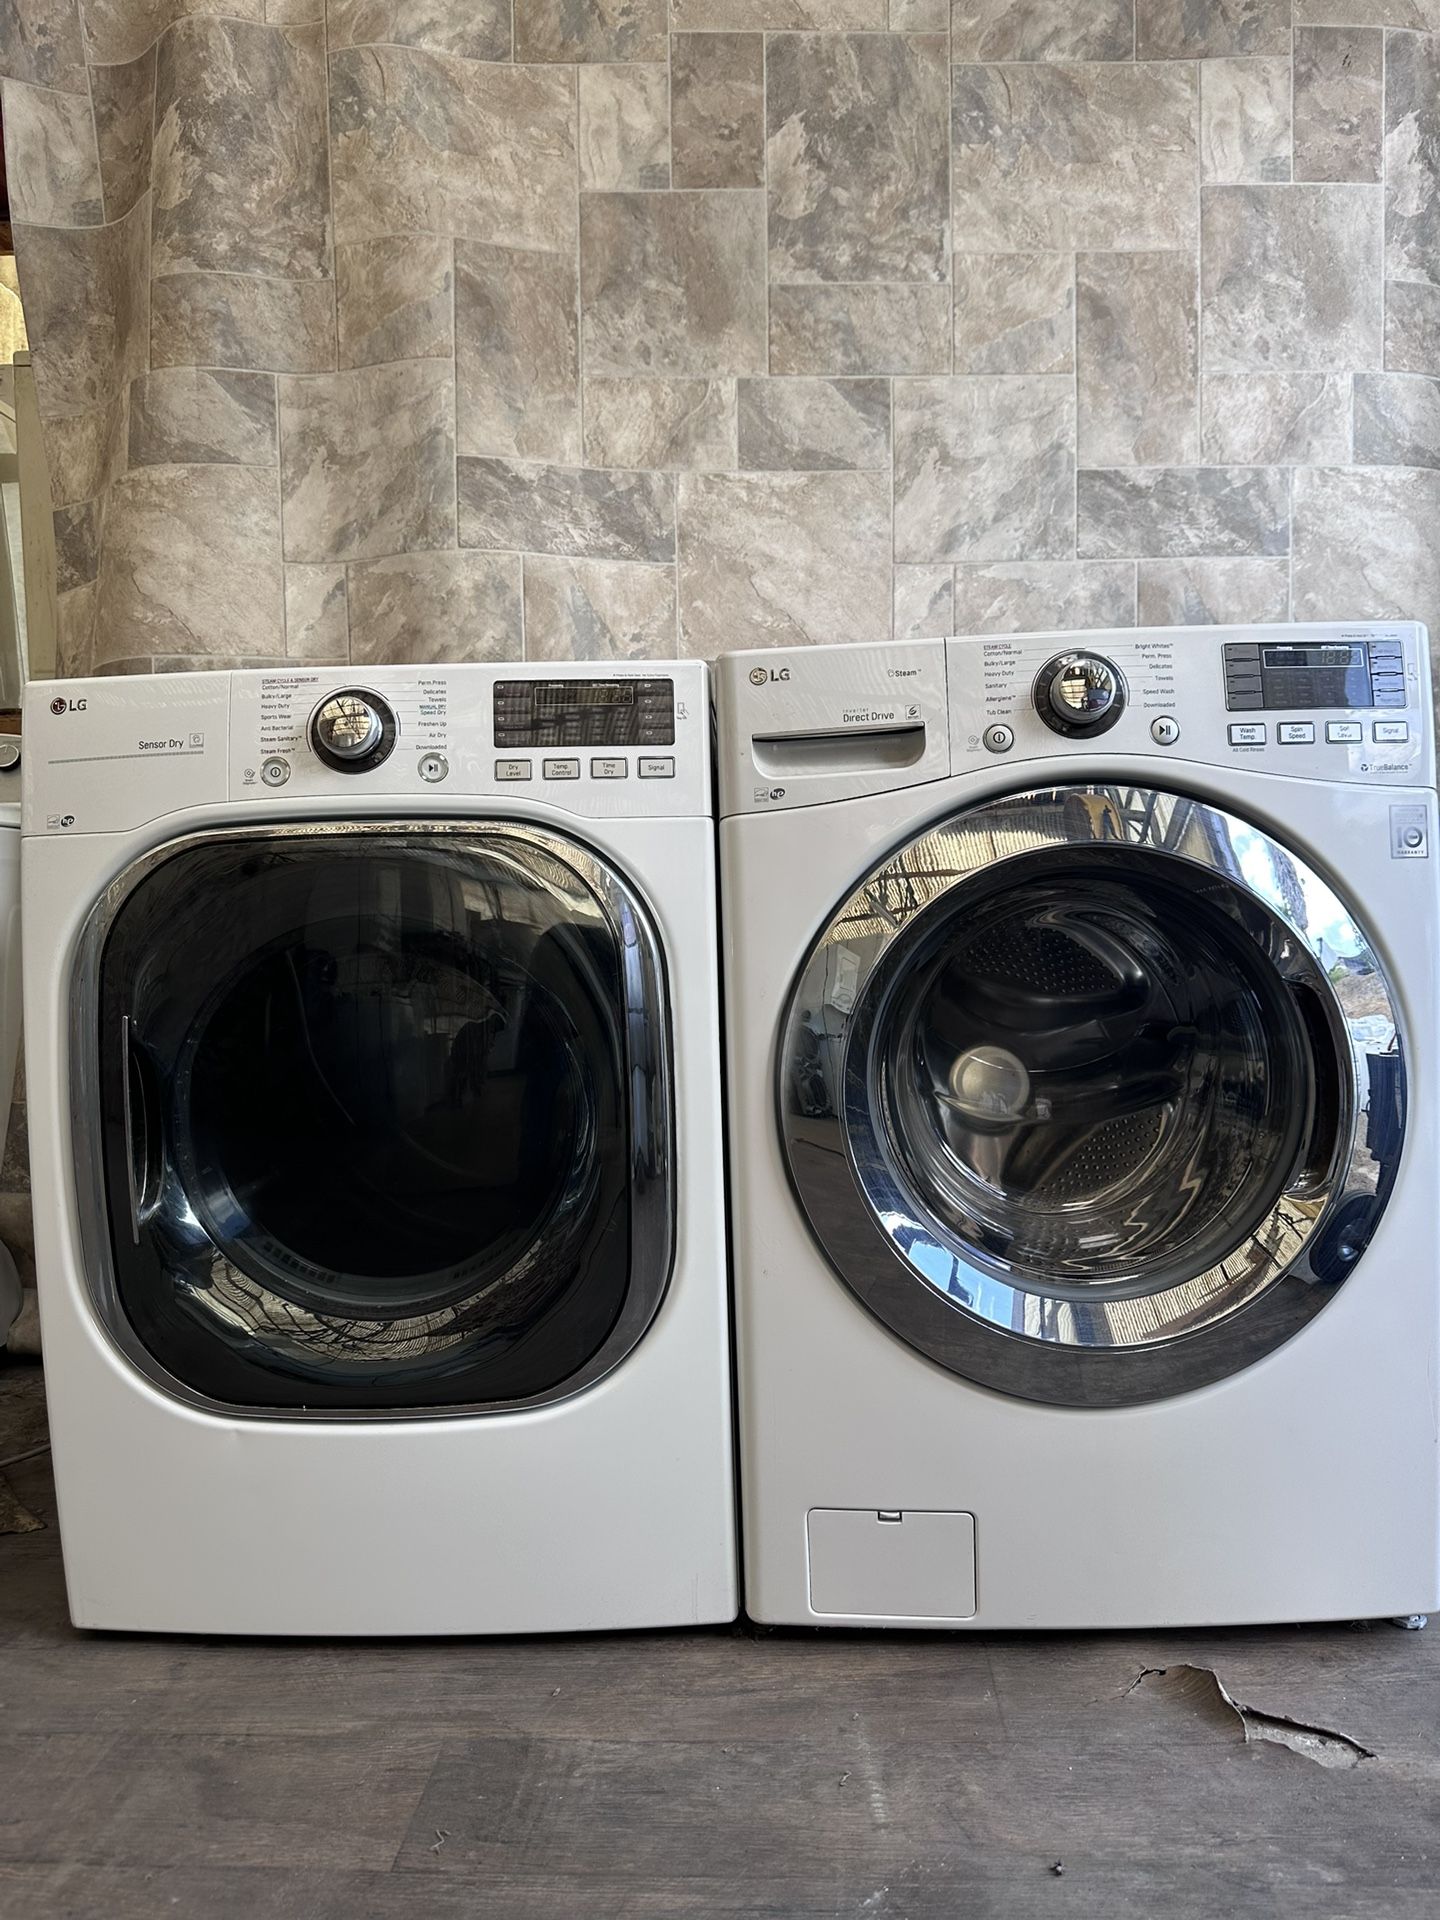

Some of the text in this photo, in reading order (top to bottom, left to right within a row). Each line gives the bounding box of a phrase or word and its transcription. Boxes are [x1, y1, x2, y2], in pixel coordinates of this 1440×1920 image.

[770, 668, 791, 682] LG
[69, 699, 87, 711] LG
[843, 712, 895, 723] Direct Drive
[138, 741, 167, 750] Sensor
[169, 739, 184, 749] Dry
